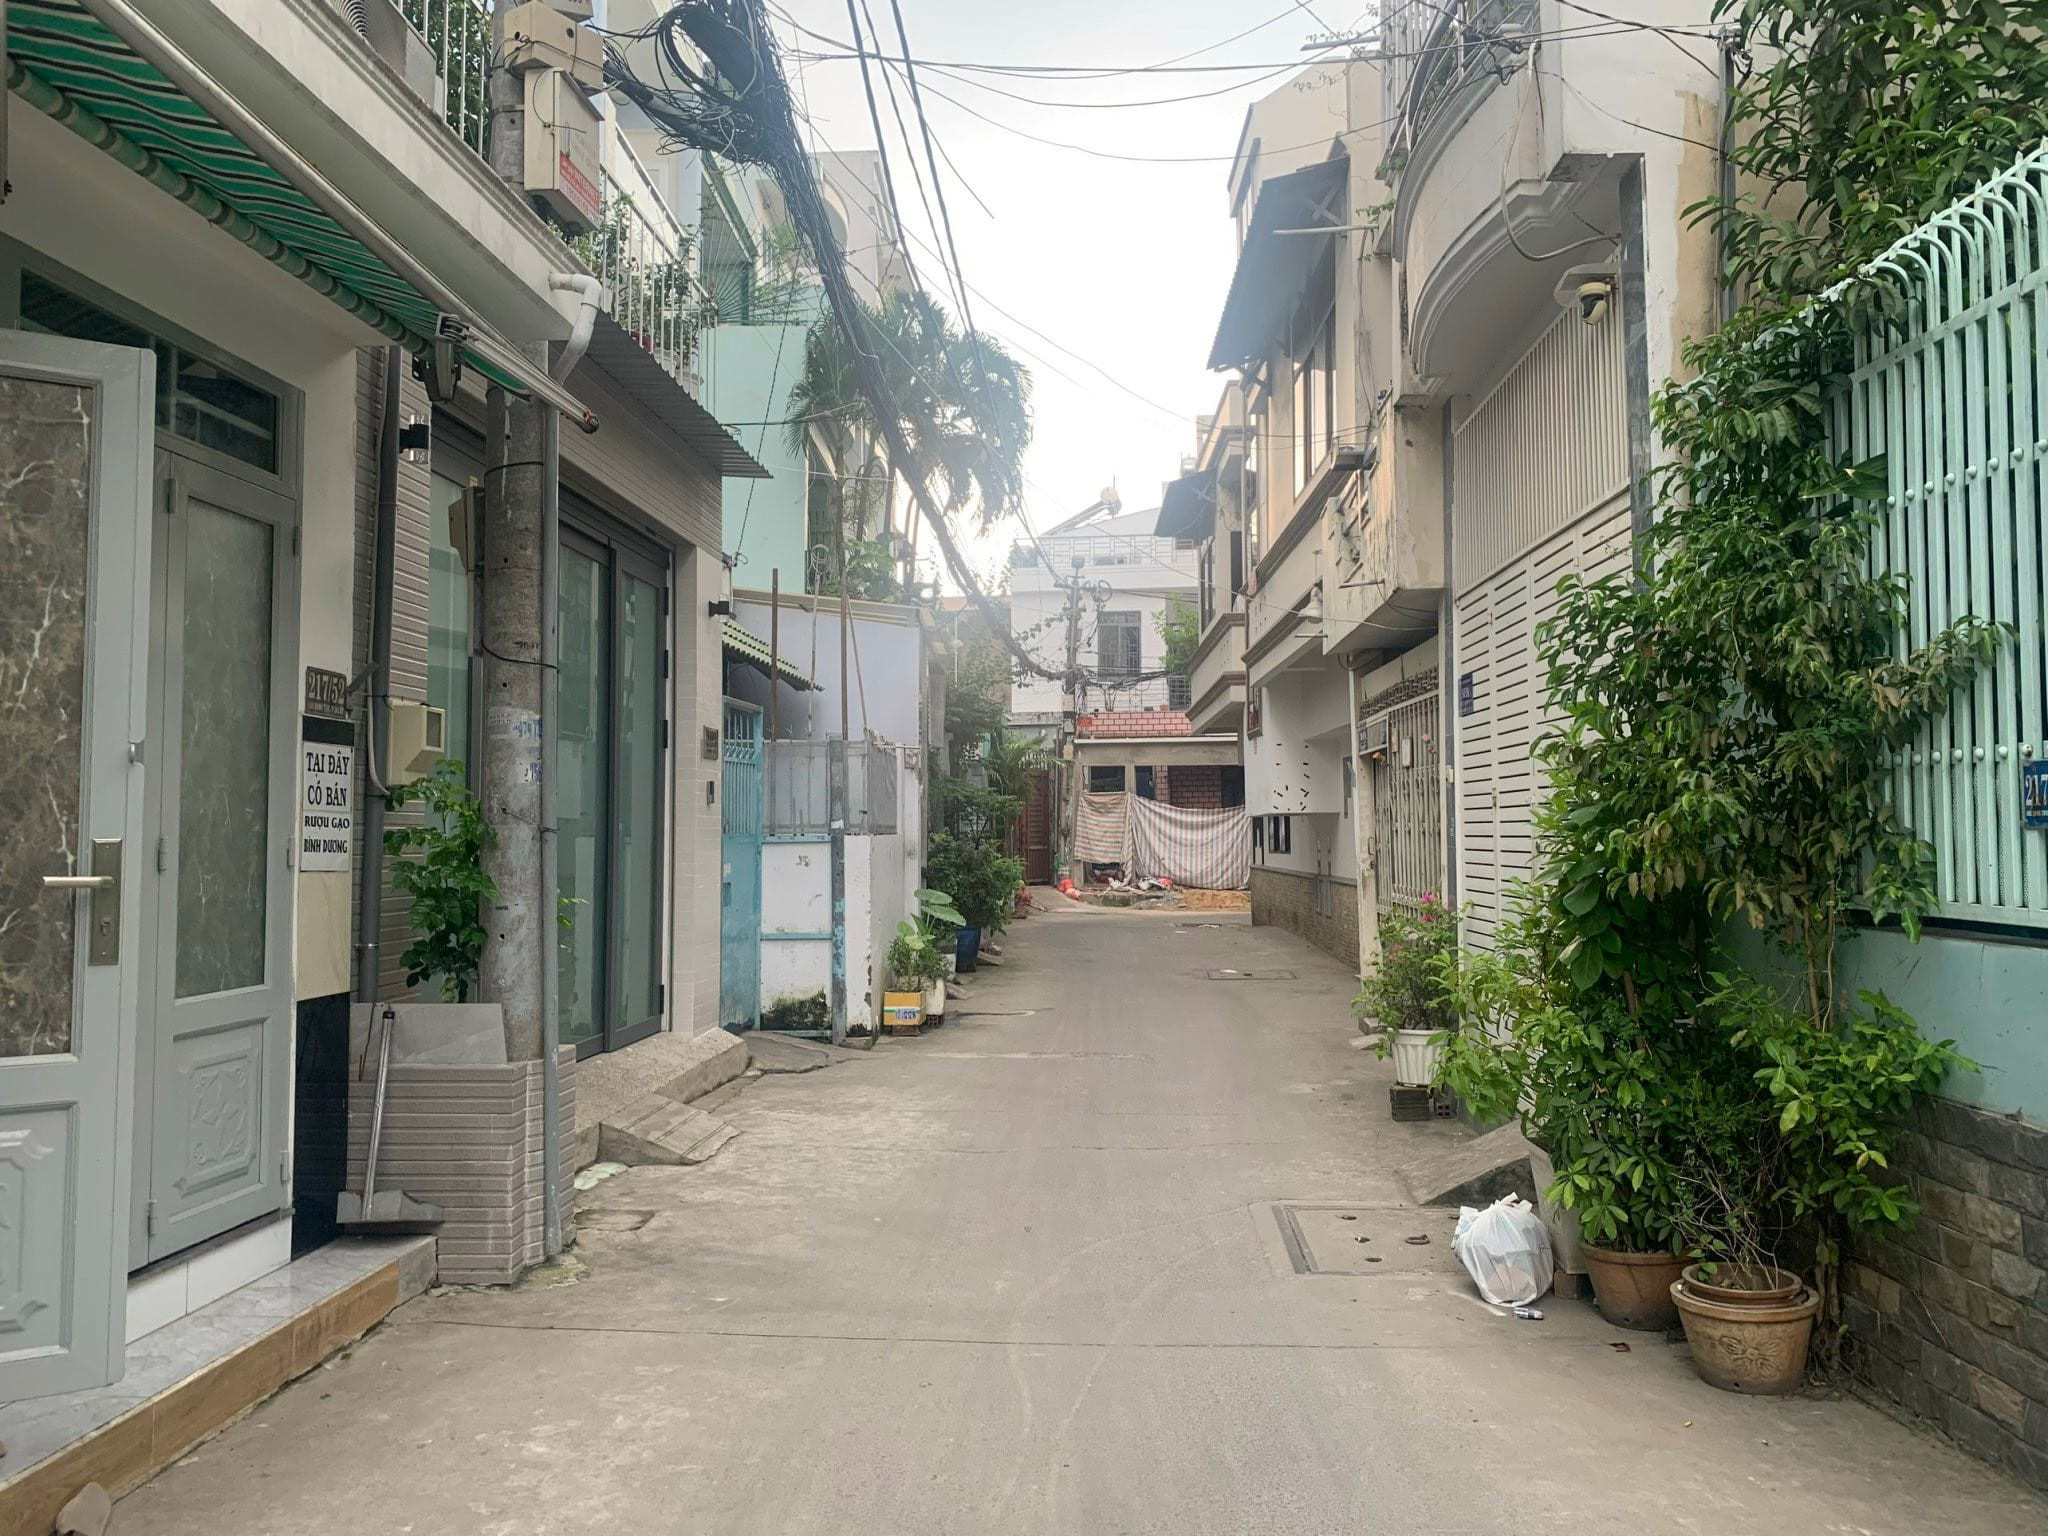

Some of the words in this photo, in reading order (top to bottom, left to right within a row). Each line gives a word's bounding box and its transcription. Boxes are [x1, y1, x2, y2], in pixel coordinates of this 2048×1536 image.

[308, 672, 345, 704] 217/52
[306, 751, 325, 778] TẠI
[328, 750, 350, 775] ĐÂY
[308, 780, 322, 805] CÓ
[326, 781, 347, 806] BÁN
[304, 815, 329, 830] RƯỢU
[331, 817, 350, 831] GẠO
